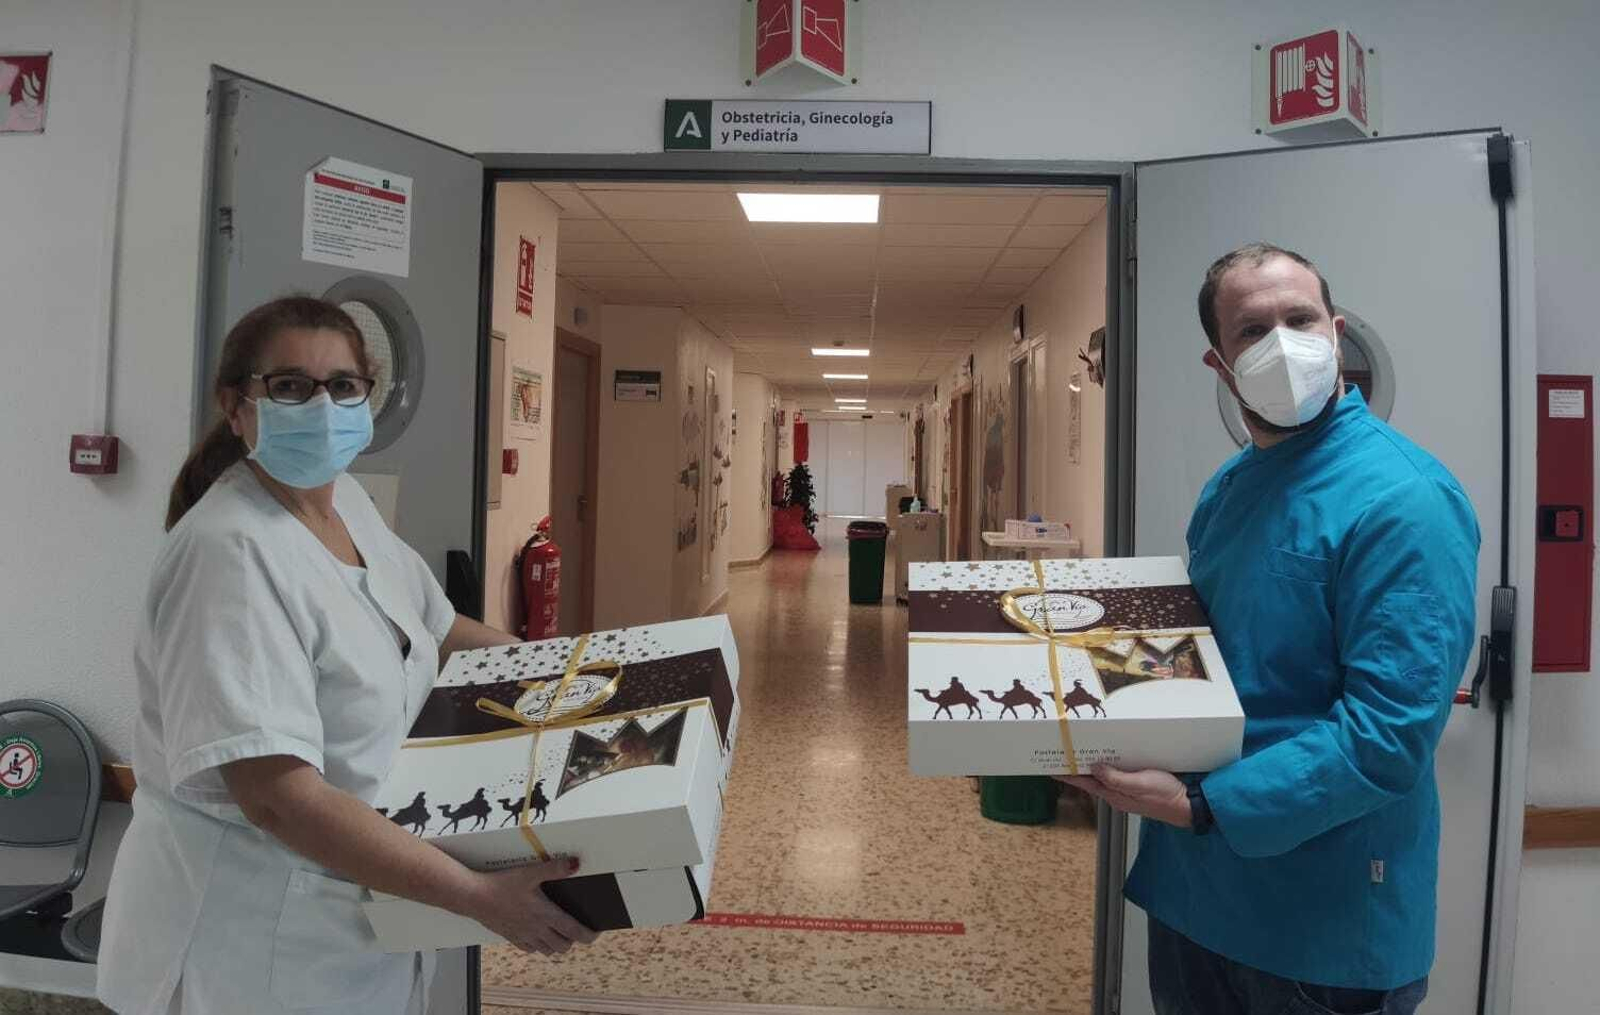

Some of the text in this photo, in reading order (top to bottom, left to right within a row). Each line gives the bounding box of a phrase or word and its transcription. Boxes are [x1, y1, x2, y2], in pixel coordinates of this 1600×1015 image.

[721, 111, 894, 128] Obstetricia, Ginecología
[721, 129, 798, 144] y Pediatría
[871, 923, 954, 932] SEGURIDAD
